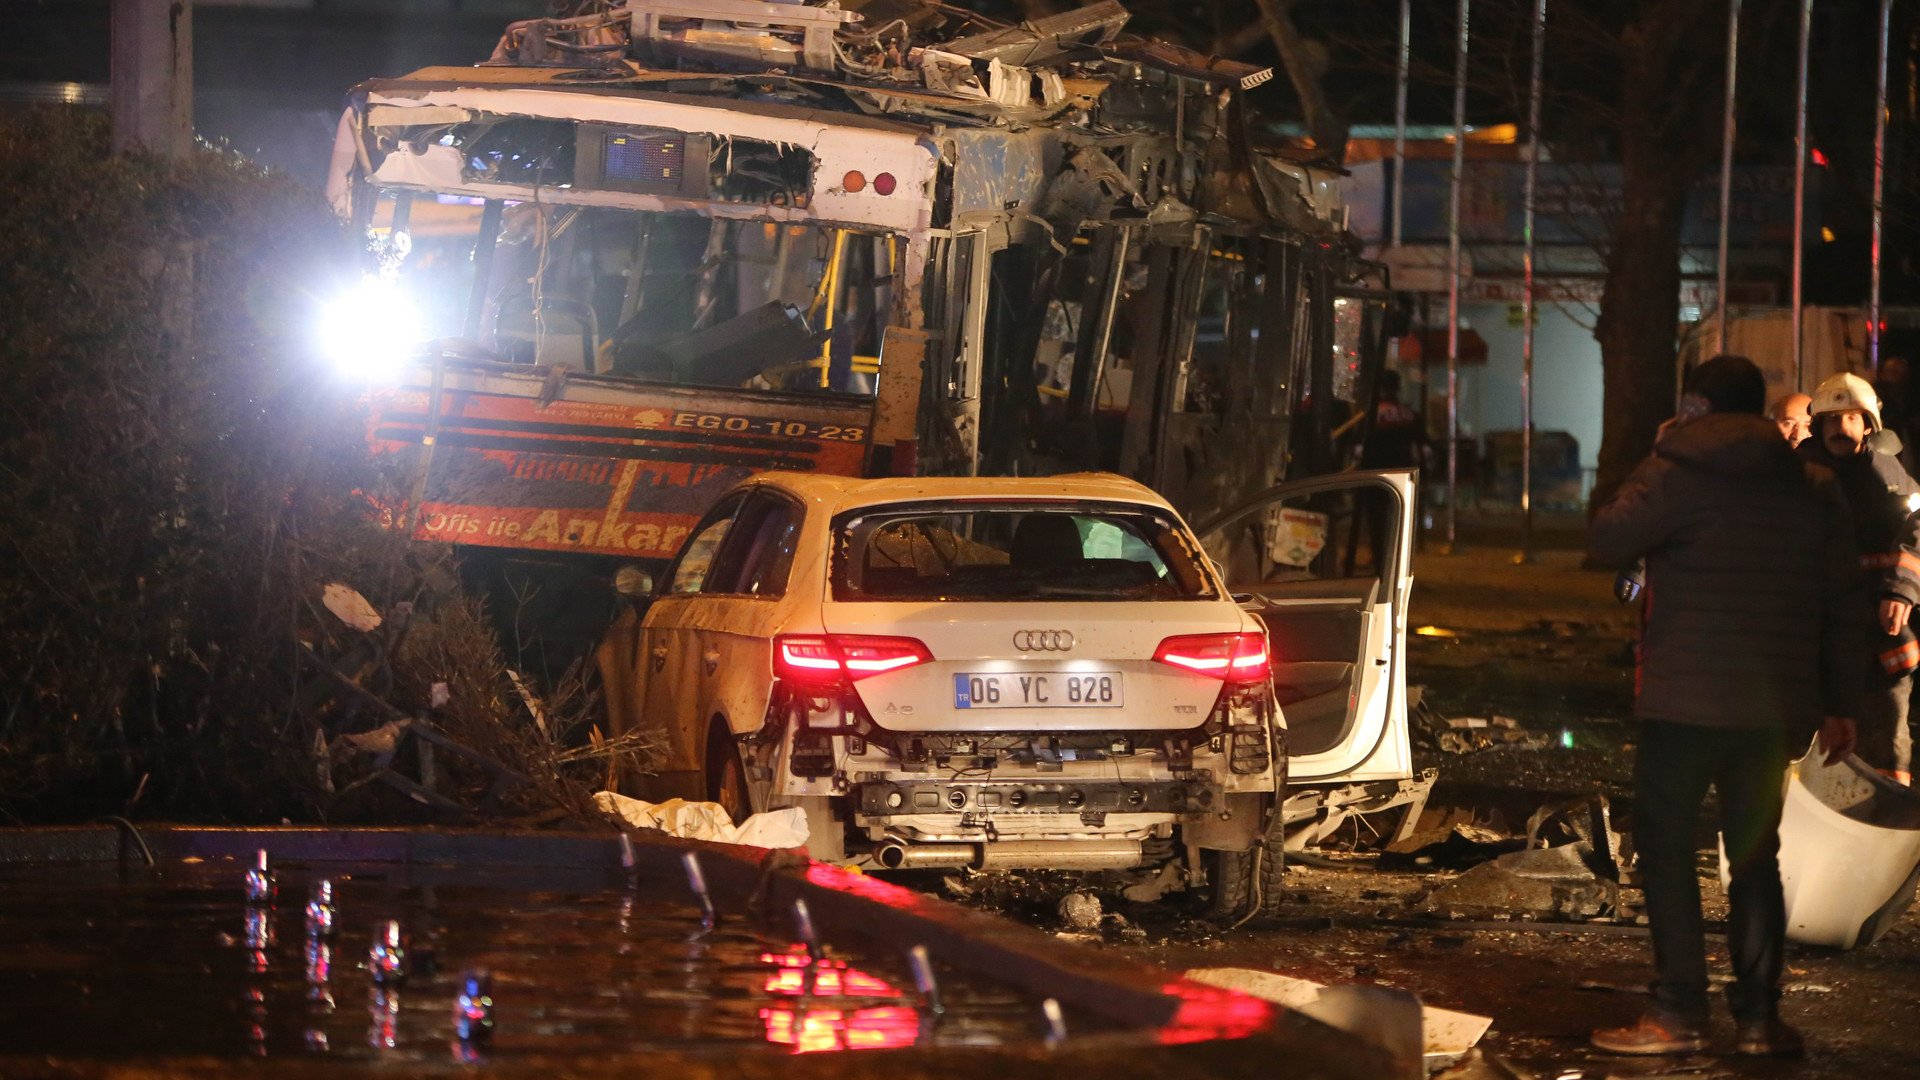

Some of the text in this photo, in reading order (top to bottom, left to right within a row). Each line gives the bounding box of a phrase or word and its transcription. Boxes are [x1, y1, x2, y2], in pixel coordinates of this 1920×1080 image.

[674, 413, 865, 441] EGO-10-23
[424, 512, 480, 534] Ofis
[486, 516, 521, 538] ile
[520, 509, 693, 551] Ankar
[958, 693, 970, 702] TR
[970, 676, 1113, 703] 06 YC 828
